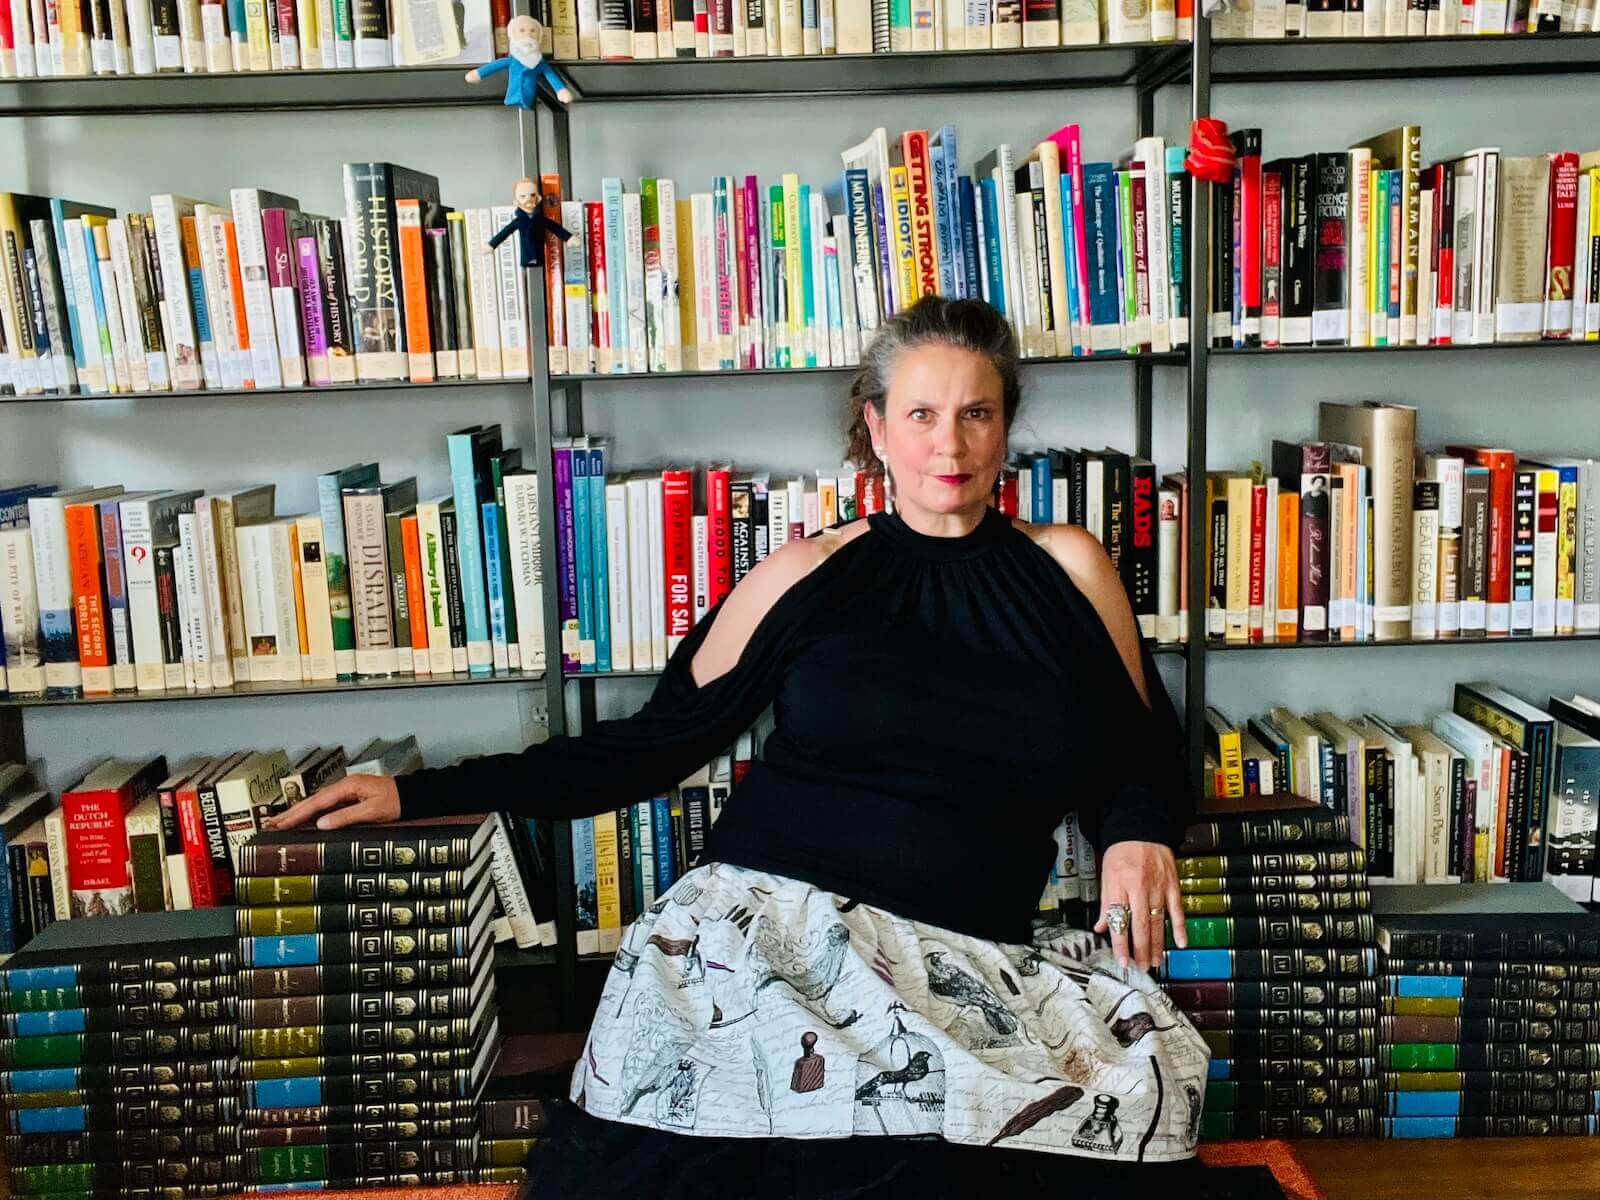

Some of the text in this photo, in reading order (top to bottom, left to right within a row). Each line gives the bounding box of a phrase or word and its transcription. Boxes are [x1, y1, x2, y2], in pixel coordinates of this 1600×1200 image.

[908, 133, 936, 295] GETTING STRONG
[1170, 180, 1182, 225] MULTIPLE
[1296, 179, 1306, 197] Story
[1358, 159, 1368, 224] STEVE ALLEN
[1407, 135, 1421, 256] SUPERMAN
[211, 223, 223, 244] Back
[214, 246, 224, 255] To
[365, 194, 396, 301] HISTORY
[850, 178, 872, 276] MOUNTAINEERING
[896, 198, 912, 258] IDIOT'S
[1131, 210, 1147, 270] Dictionary of
[326, 275, 335, 289] Idea
[328, 300, 343, 344] HISTORY
[513, 484, 534, 587] BARBARA W. TUCHMAN
[525, 483, 546, 586] A DISTANT MIRROR
[1110, 500, 1121, 547] The Ties
[1134, 476, 1152, 547] RADS
[1390, 456, 1402, 588] AN AMERICAN ALBUM
[1418, 514, 1435, 547] BEAT
[1584, 512, 1594, 554] TRAMP
[714, 518, 728, 585] GOOD TO
[738, 521, 748, 573] AGAINST
[1474, 534, 1483, 573] AMERICAN
[7, 543, 22, 624] THE PITY OF WAR
[357, 542, 393, 648] DISRAELI
[424, 531, 444, 628] A History of Ireland
[670, 574, 687, 605] FOR
[1582, 557, 1594, 602] ABROAD
[77, 593, 91, 656] WORLD WAR
[91, 615, 102, 656] SECOND
[1224, 747, 1237, 768] TIM
[1325, 747, 1334, 782] LARRY
[70, 820, 114, 830] REPUBLIC
[74, 812, 108, 821] DUTCH
[200, 792, 226, 860] BEIRUT DIARY
[1366, 806, 1376, 862] BENNINGTON
[1429, 784, 1445, 845] Seven Plays
[1578, 808, 1591, 856] SAGAS
[506, 854, 529, 916] MASQUERADE
